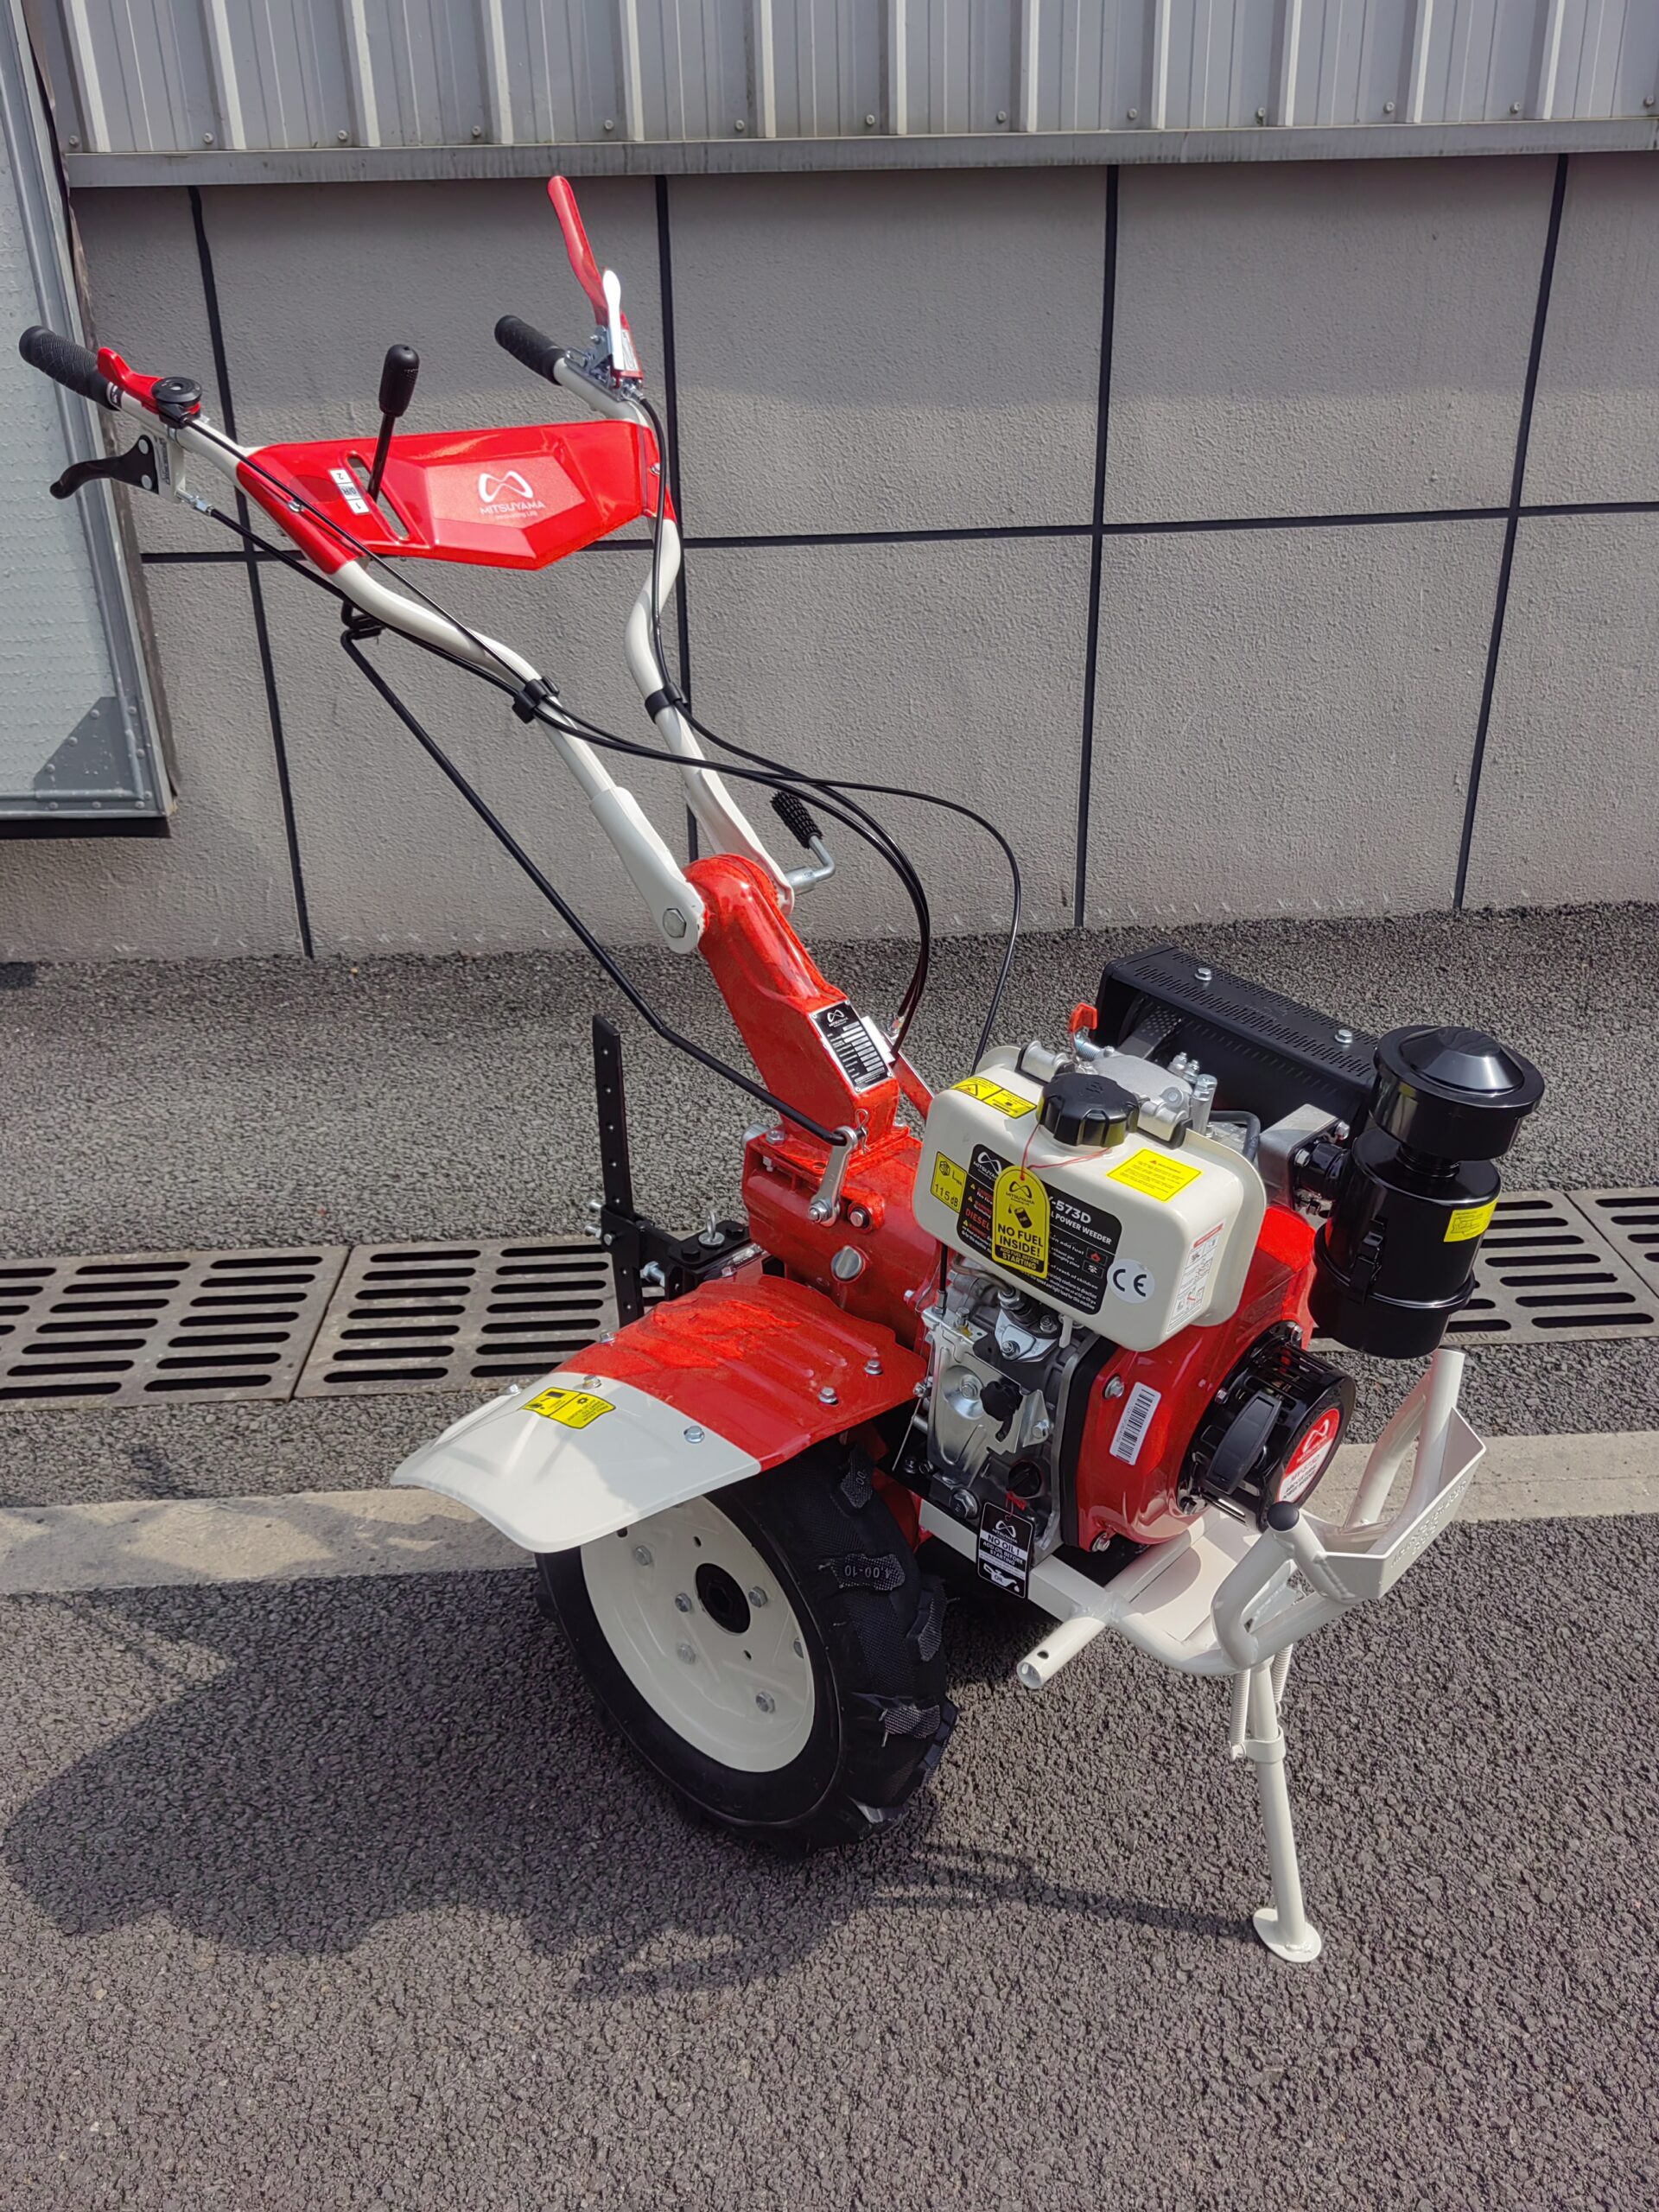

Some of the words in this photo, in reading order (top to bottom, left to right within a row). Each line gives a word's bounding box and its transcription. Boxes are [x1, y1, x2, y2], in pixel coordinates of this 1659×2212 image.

[479, 500, 546, 515] MITSUYAMA
[973, 1160, 997, 1179] MITSUYA
[965, 1208, 990, 1230] DIESEL
[1055, 1213, 1081, 1230] POWER
[1082, 1226, 1112, 1244] WEEDER
[998, 1223, 1014, 1236] NO
[1018, 1230, 1043, 1247] FUEL
[1000, 1236, 1040, 1257] INSIDE!
[1002, 1253, 1037, 1270] STARTING
[1113, 1268, 1147, 1297] CE
[983, 1541, 995, 1551] ADD
[988, 1535, 1001, 1546] NO
[1001, 1541, 1014, 1554] OIL
